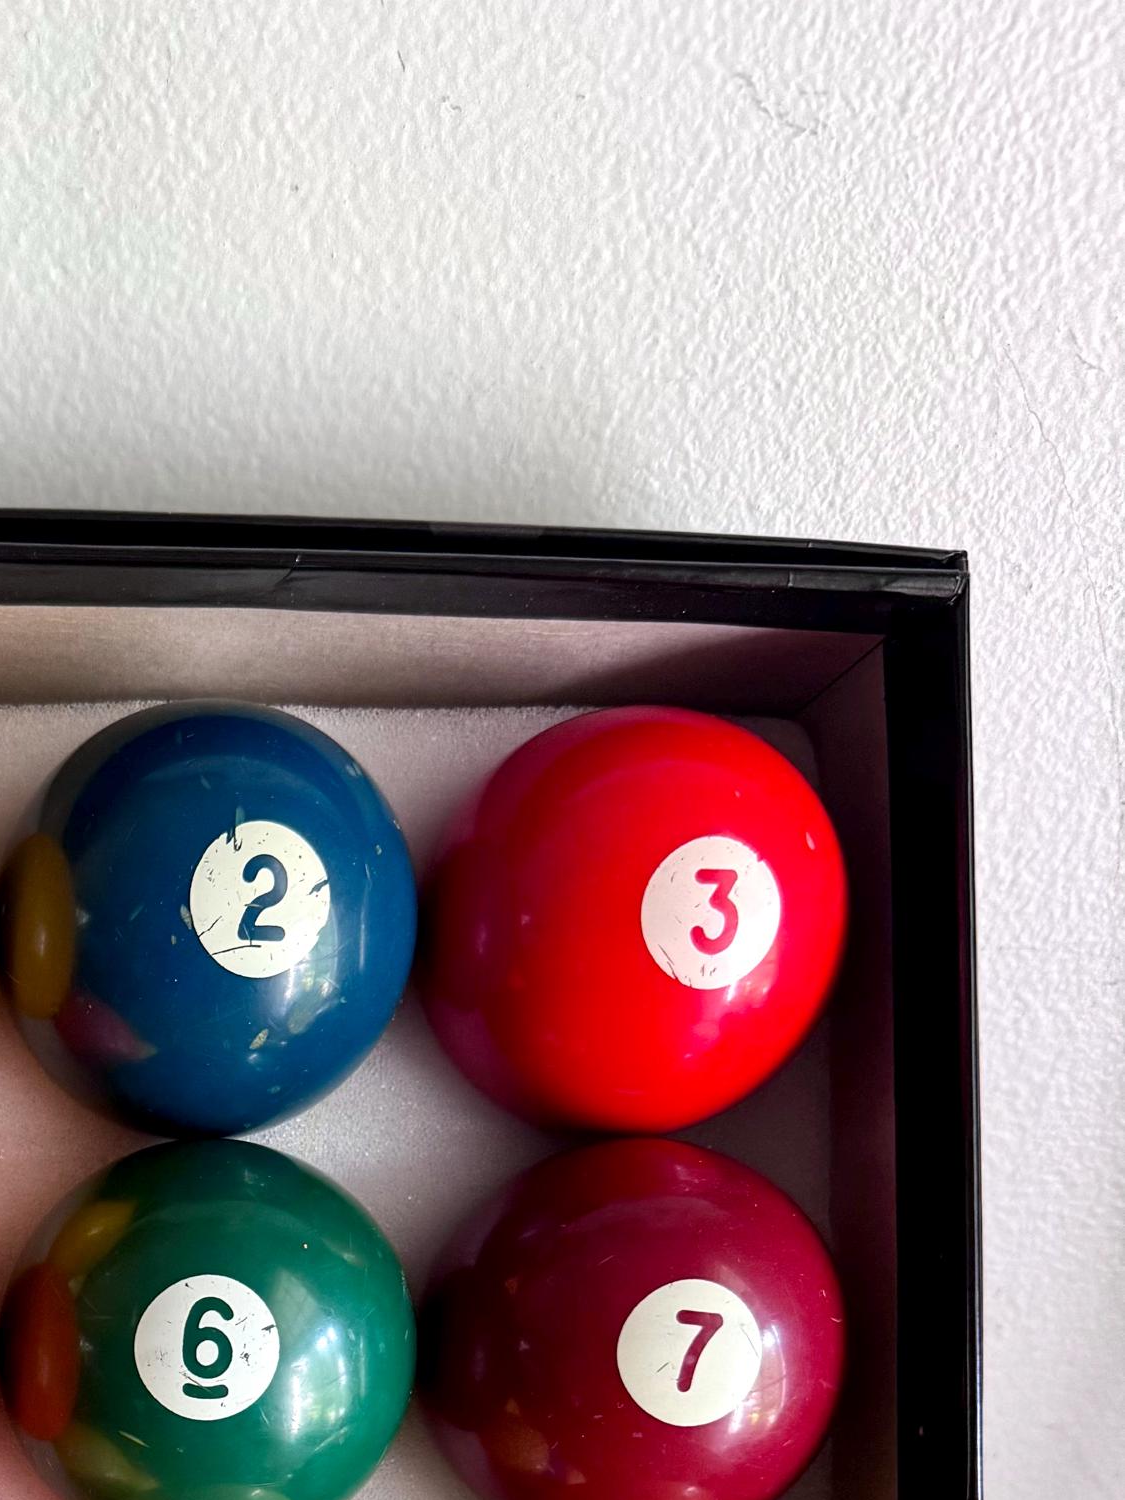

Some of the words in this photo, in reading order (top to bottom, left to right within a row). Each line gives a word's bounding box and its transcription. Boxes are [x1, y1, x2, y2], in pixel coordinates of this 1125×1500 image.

[240, 853, 288, 941] 2
[691, 868, 740, 955] 3
[182, 1296, 235, 1400] 6
[675, 1308, 723, 1392] 7
